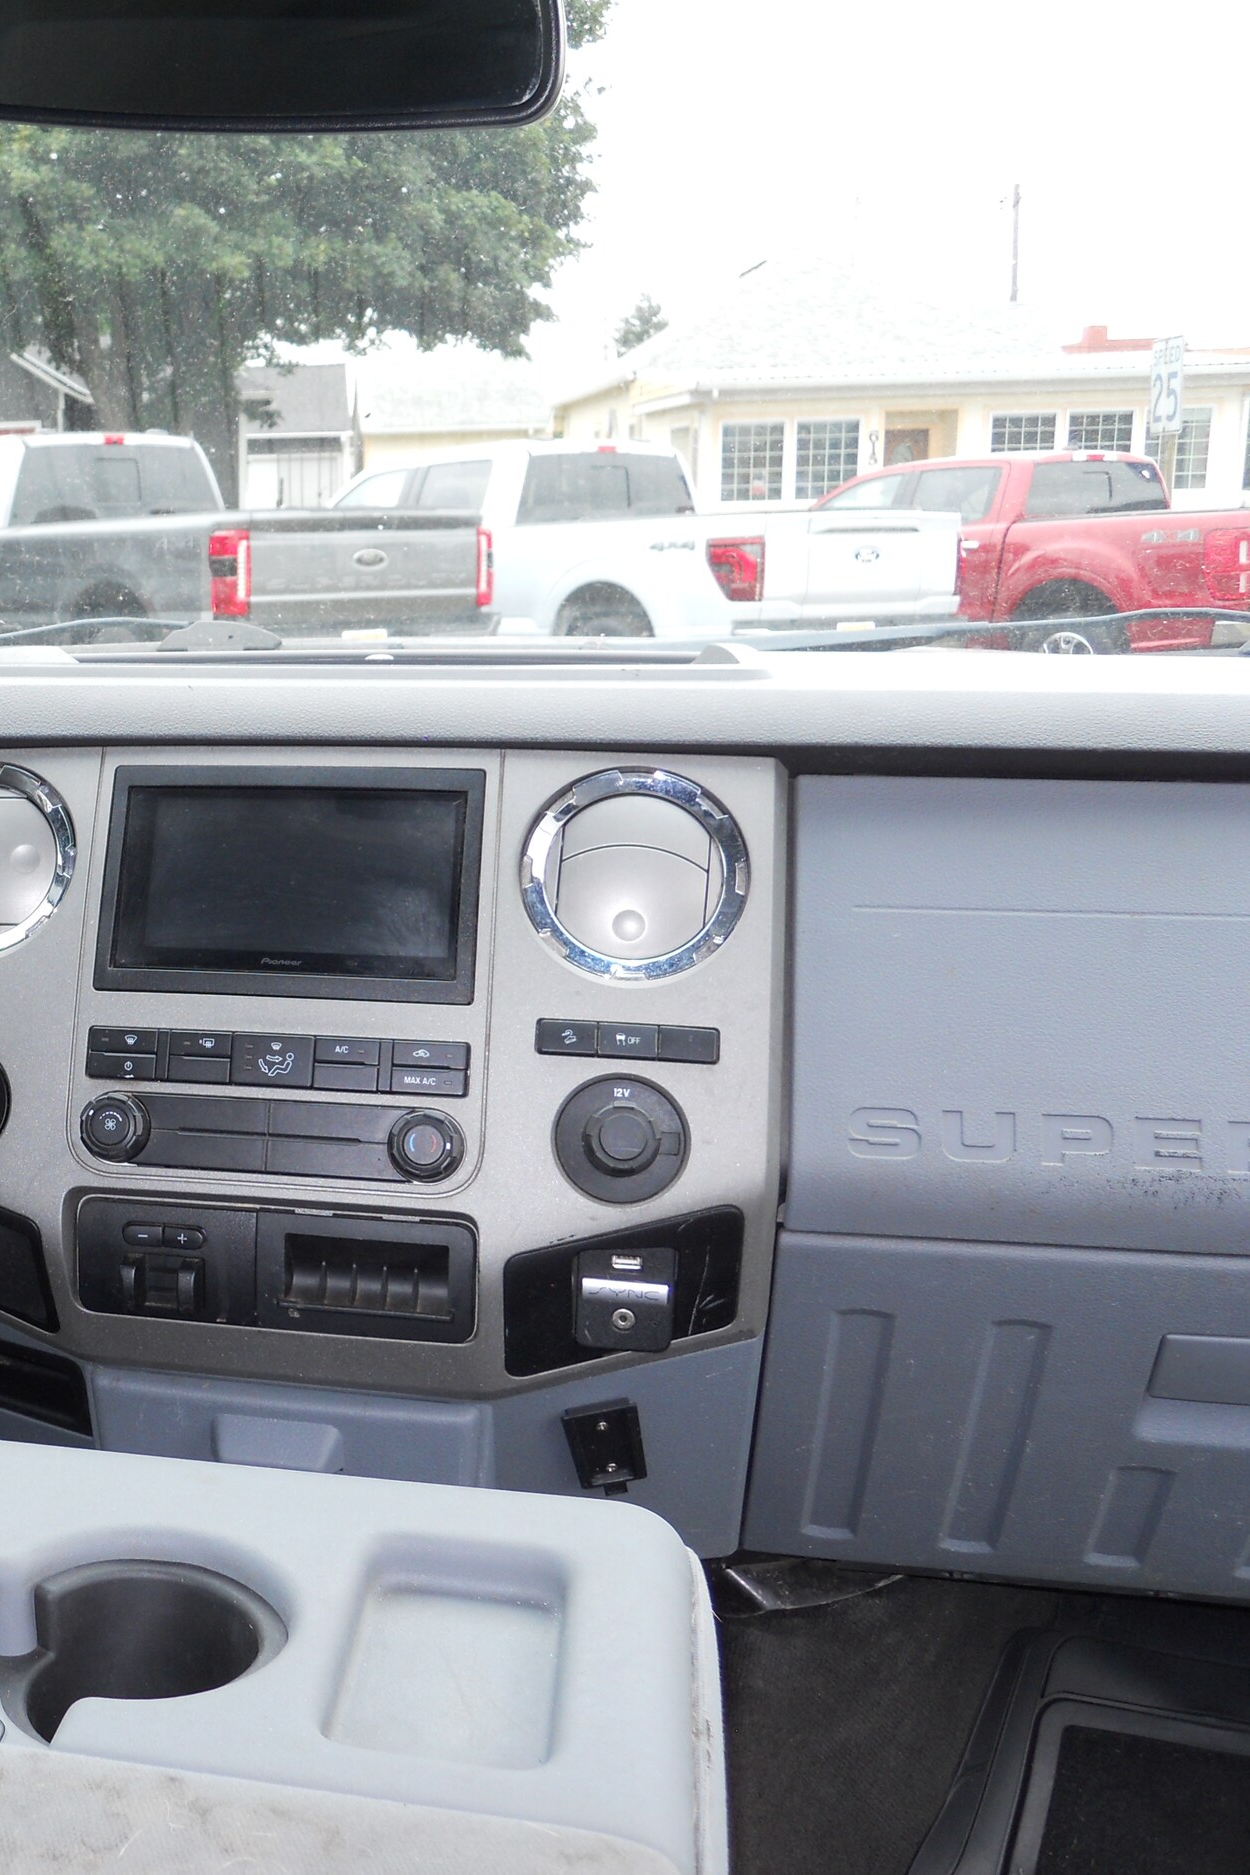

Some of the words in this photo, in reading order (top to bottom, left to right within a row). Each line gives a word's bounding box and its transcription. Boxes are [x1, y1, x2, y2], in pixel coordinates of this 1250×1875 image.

[1153, 372, 1178, 423] 25
[260, 957, 302, 966] Pioneer
[627, 1036, 641, 1045] OFF
[334, 1045, 349, 1054] A/C
[403, 1076, 421, 1084] MAX
[422, 1077, 437, 1085] A/C
[613, 1087, 630, 1097] 12V
[588, 1286, 660, 1301] SYNC
